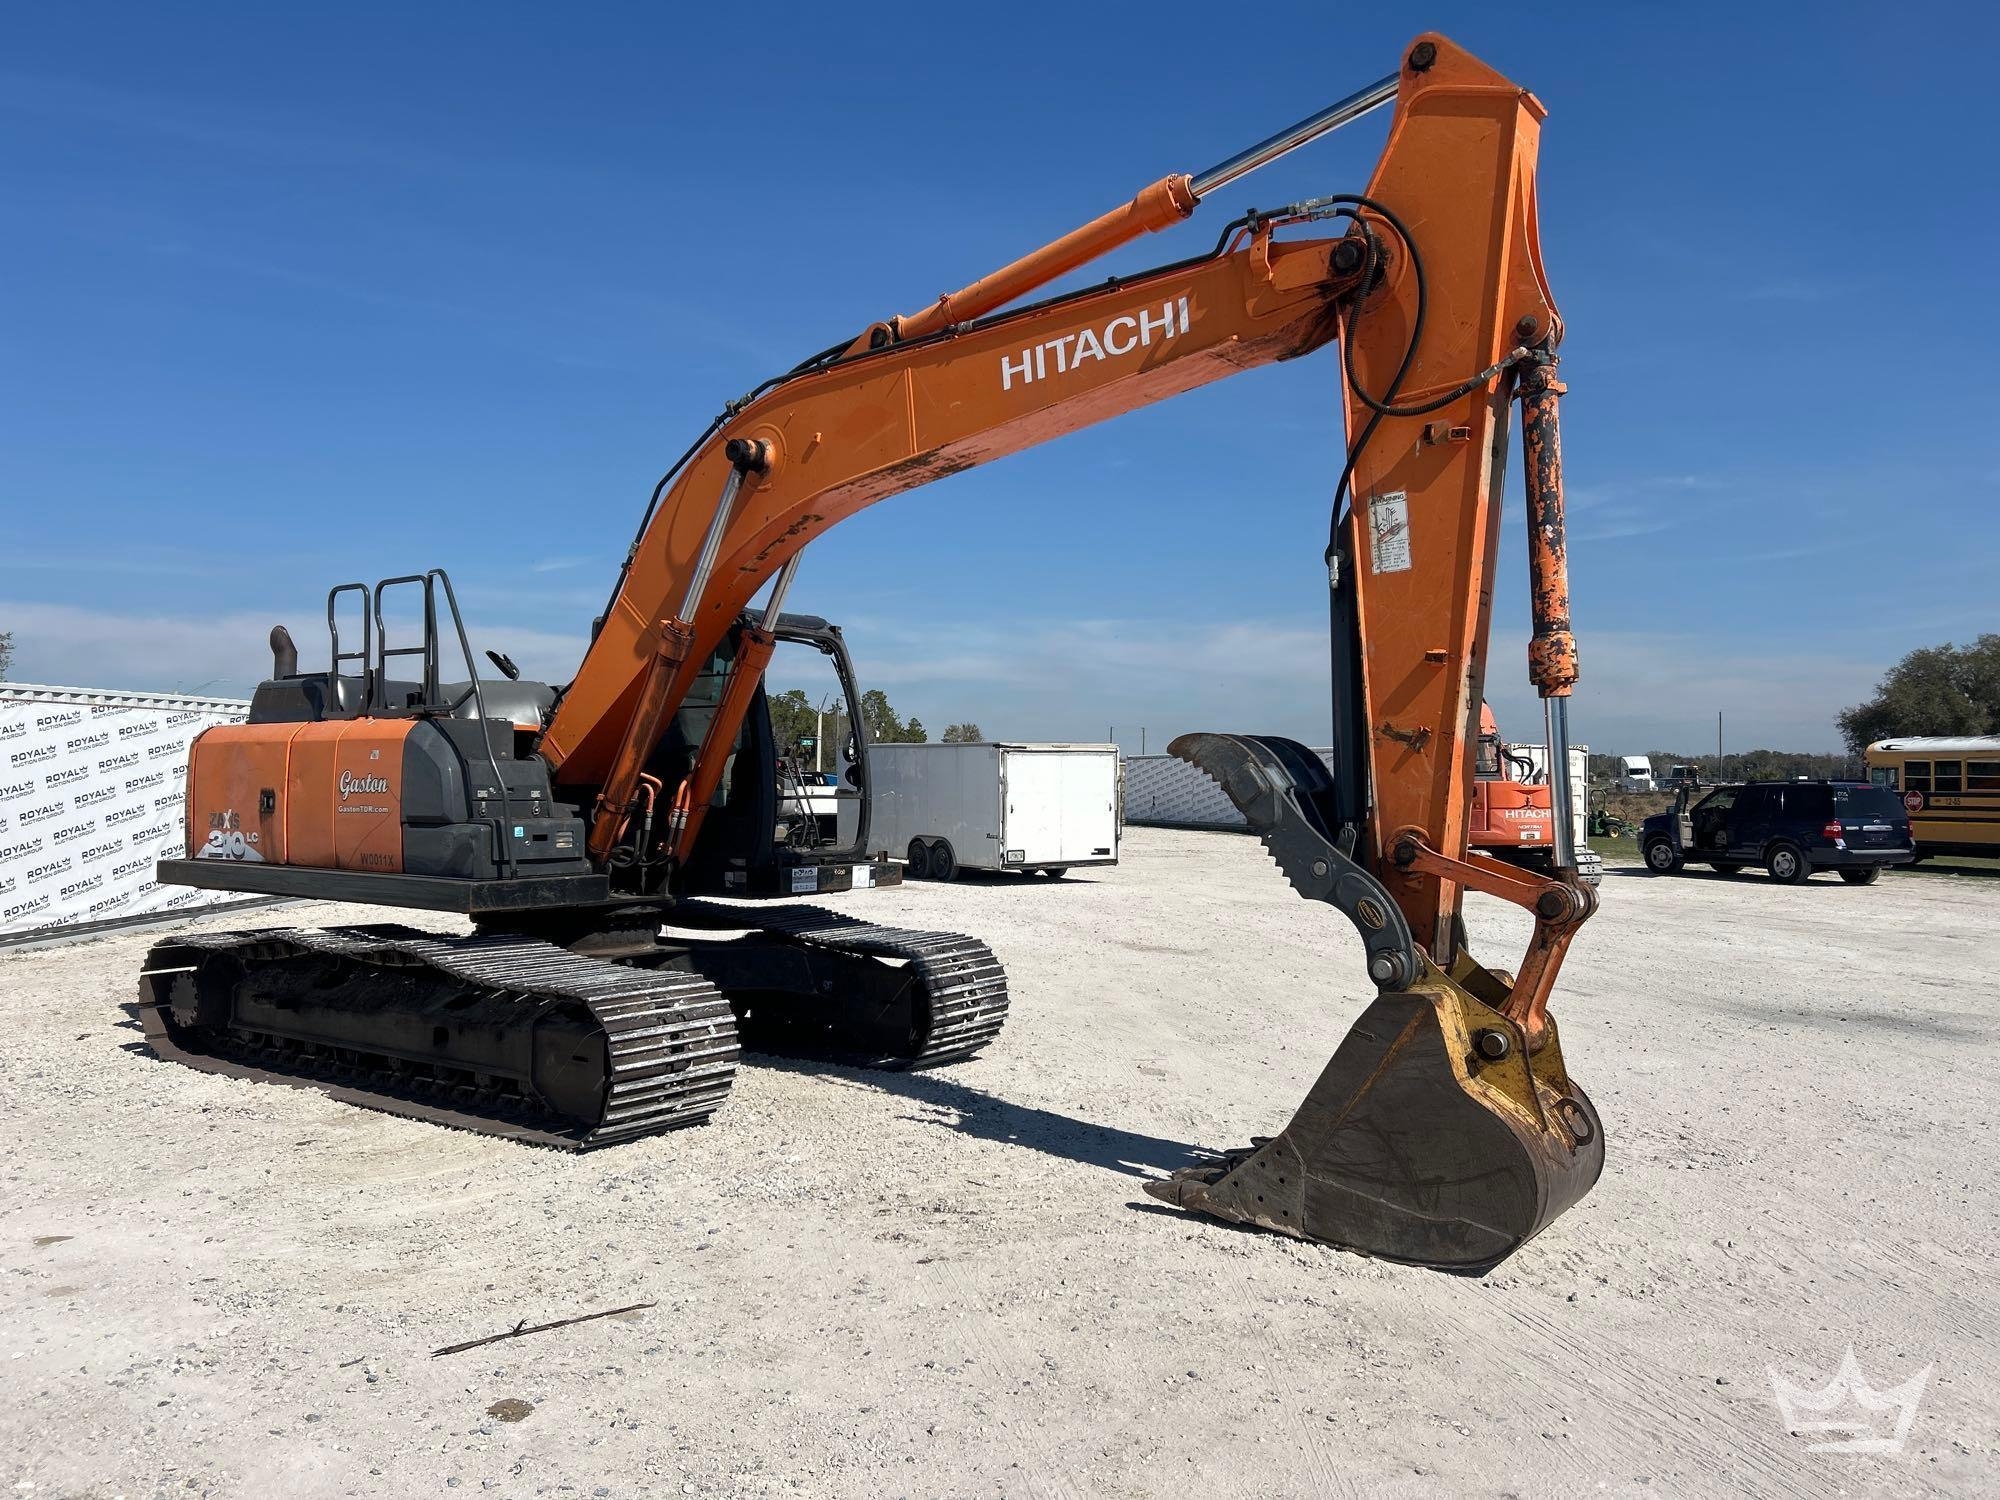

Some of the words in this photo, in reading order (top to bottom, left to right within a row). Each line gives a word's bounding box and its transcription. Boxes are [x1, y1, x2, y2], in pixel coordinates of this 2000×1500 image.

[1001, 296, 1190, 391] HITACHI
[36, 713, 72, 726] ROYAL
[166, 712, 194, 724] ROYAL
[38, 724, 62, 732] AUCTION
[119, 723, 150, 736] ROYAL
[67, 735, 100, 748] ROYAL
[120, 733, 142, 741] AUCTION
[11, 748, 47, 762] ROYAL
[68, 746, 91, 754] AUCTION
[148, 742, 176, 755] ROYAL
[99, 755, 130, 768] ROYAL
[150, 752, 169, 760] AUCTION
[12, 759, 37, 768] AUCTION
[100, 765, 122, 774] AUCTION
[122, 760, 140, 768] GROUP
[172, 764, 188, 774] ROY
[46, 769, 80, 784] ROYAL
[47, 780, 70, 789] AUCTION
[71, 774, 89, 782] GROUP
[126, 774, 156, 788] ROYAL
[127, 785, 148, 794] AUCTION
[340, 770, 388, 801] Gaston
[16, 789, 35, 798] GROUP
[74, 790, 107, 804] ROYAL
[155, 793, 183, 806] ROYAL
[76, 800, 98, 809] AUCTION
[99, 794, 116, 802] GROUP
[156, 802, 176, 812] AUCTION
[20, 805, 55, 820] ROYAL
[106, 808, 137, 822] ROYAL
[338, 805, 389, 813] GastonTDR.com
[21, 816, 46, 826] AUCTION
[46, 810, 64, 819] GROUP
[106, 818, 128, 828] AUCTION
[129, 812, 146, 820] GROUP
[54, 824, 86, 840] ROYAL
[55, 836, 78, 846] AUCTION
[78, 828, 96, 837] GROUP
[132, 826, 162, 840] ROYAL
[134, 836, 154, 846] AUCTION
[155, 830, 170, 838] GROUP
[246, 832, 258, 842] LC
[24, 846, 43, 856] GROUP
[82, 843, 114, 859] ROYAL
[83, 854, 105, 864] AUCTION
[106, 847, 123, 856] GROUP
[160, 844, 184, 858] ROYA
[27, 862, 62, 878] ROYAL
[29, 872, 52, 884] AUCTION
[53, 866, 72, 876] GROUP
[112, 860, 144, 876] ROYAL
[114, 870, 136, 880] AUCTION
[136, 864, 152, 872] GROUP
[60, 878, 94, 896] ROYAL
[62, 890, 84, 901] AUCTION
[85, 882, 103, 891] GROUP
[90, 896, 122, 913] ROYAL
[113, 900, 130, 909] GROUP
[167, 891, 194, 907] ROYAL
[4, 899, 40, 918] ROYAL
[6, 911, 30, 924] AUCTION
[32, 903, 50, 914] GROUP
